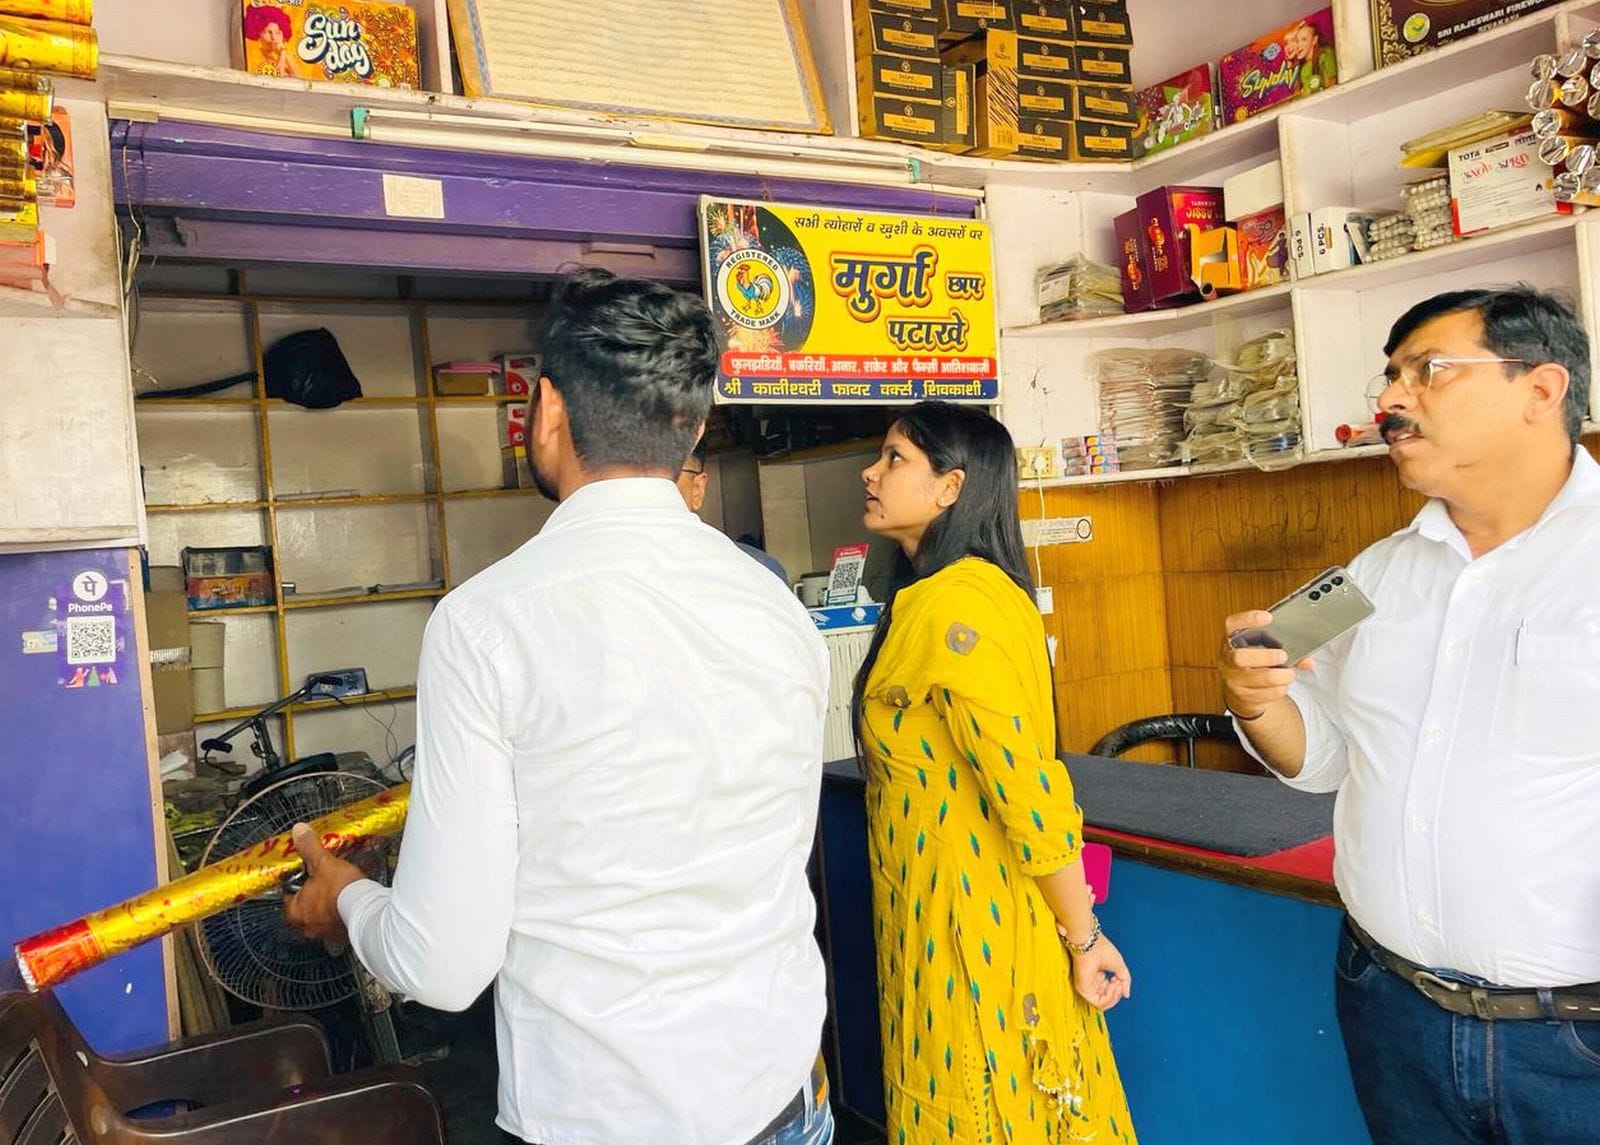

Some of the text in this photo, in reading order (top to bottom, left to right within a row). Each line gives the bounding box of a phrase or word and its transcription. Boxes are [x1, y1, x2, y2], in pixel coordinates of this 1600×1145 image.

[1437, 0, 1549, 39] SRI RAJESWARI FIREWO
[298, 14, 360, 62] Sun
[325, 40, 372, 77] day
[1458, 151, 1480, 161] TOTA
[794, 213, 983, 240] सभी त्योहारों व खुशी के अवसरों पर
[725, 251, 779, 271] REGISTERED
[832, 249, 983, 316] मुर्गा छाप
[730, 309, 781, 327] TRADE MARK
[887, 311, 967, 347] पटाखे
[724, 378, 741, 395] श्री
[752, 378, 821, 395] कालीश्वरी
[832, 384, 871, 396] फायर
[82, 576, 98, 596] पे
[67, 602, 113, 613] PhonePe
